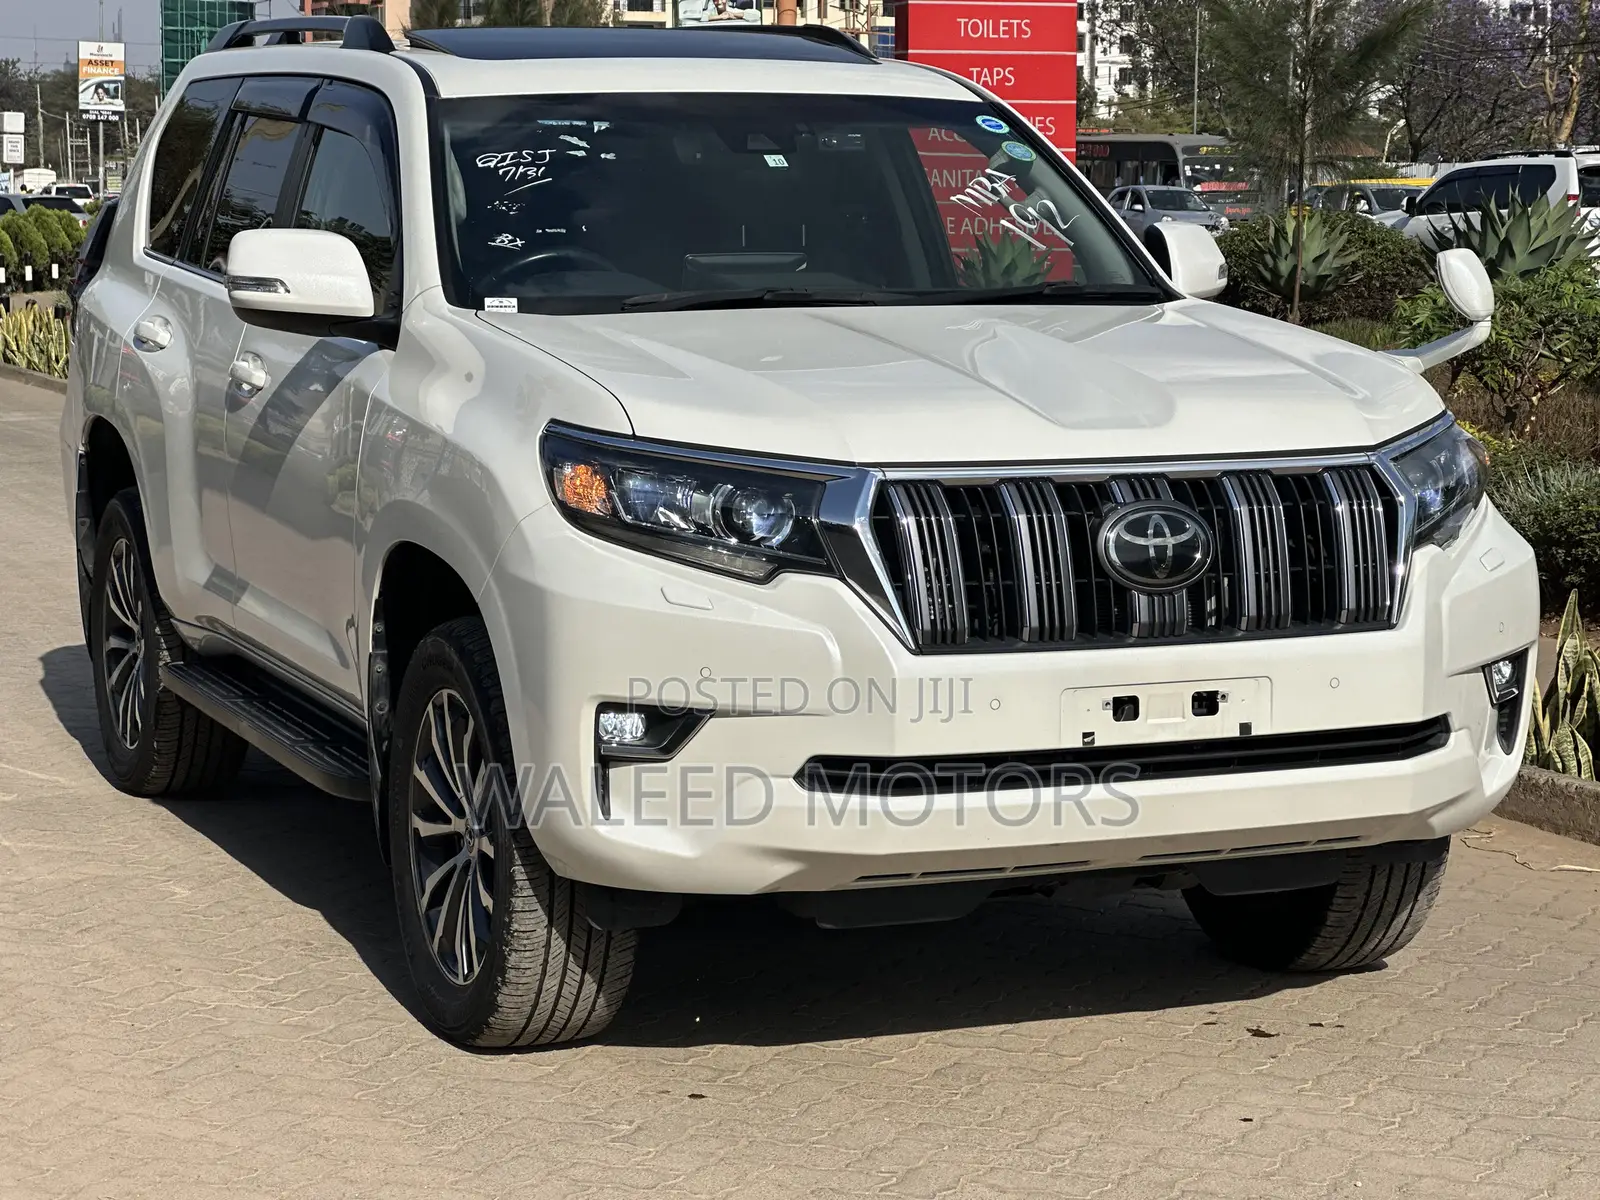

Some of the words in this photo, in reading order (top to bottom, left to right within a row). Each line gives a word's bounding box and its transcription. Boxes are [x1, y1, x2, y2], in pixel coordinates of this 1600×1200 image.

[957, 18, 1032, 38] TOILETS
[83, 67, 120, 75] FINANCE
[969, 67, 1016, 86] TAPS
